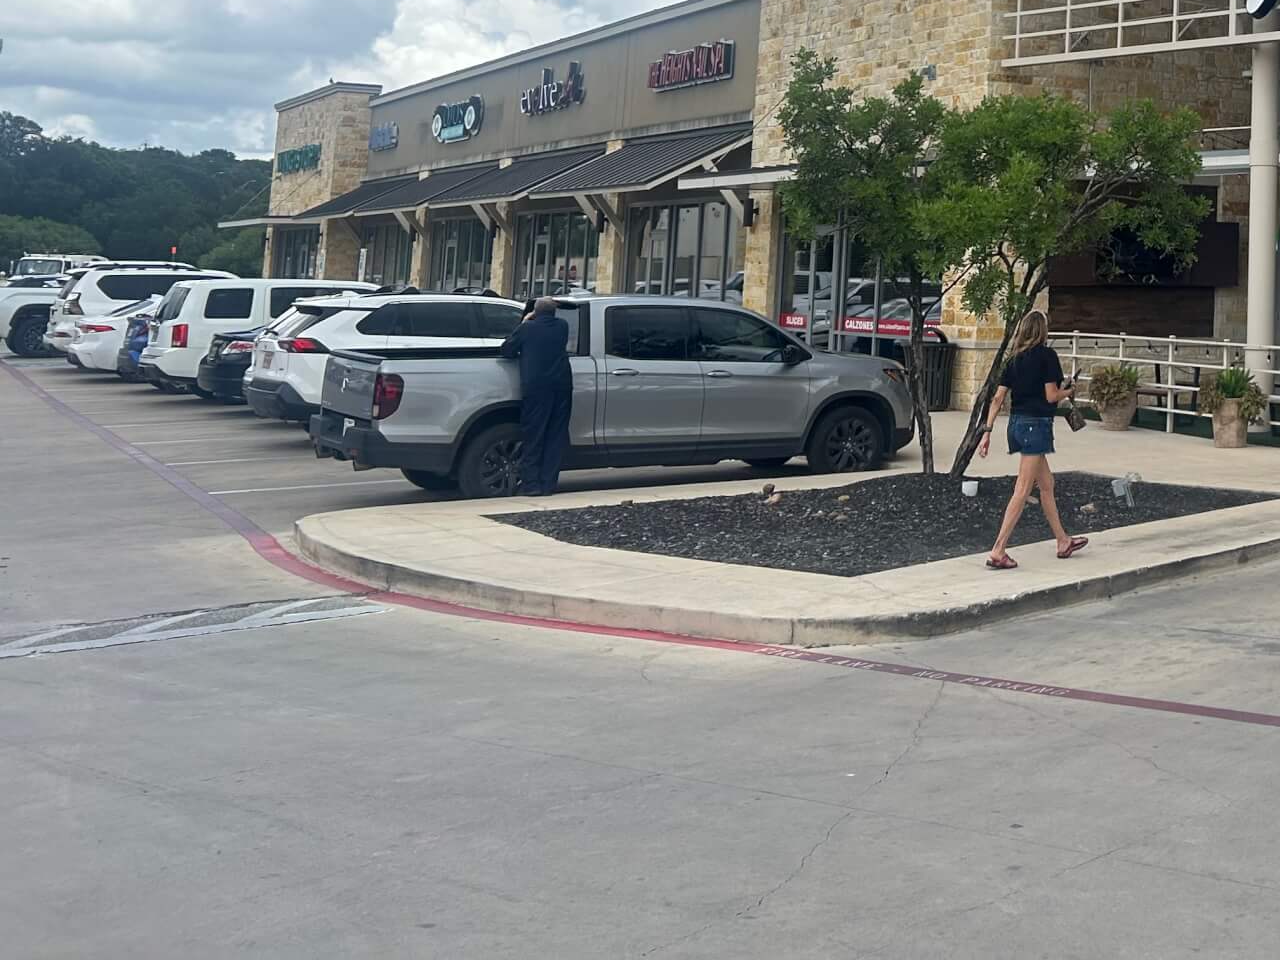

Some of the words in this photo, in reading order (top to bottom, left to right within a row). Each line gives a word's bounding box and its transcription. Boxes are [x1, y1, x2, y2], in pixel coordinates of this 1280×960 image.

[786, 316, 804, 325] SLICES
[845, 319, 874, 330] CALZONES
[754, 647, 811, 659] FIRE
[818, 656, 882, 670] LANE
[912, 670, 948, 679] NO
[960, 676, 1070, 695] PARKING
